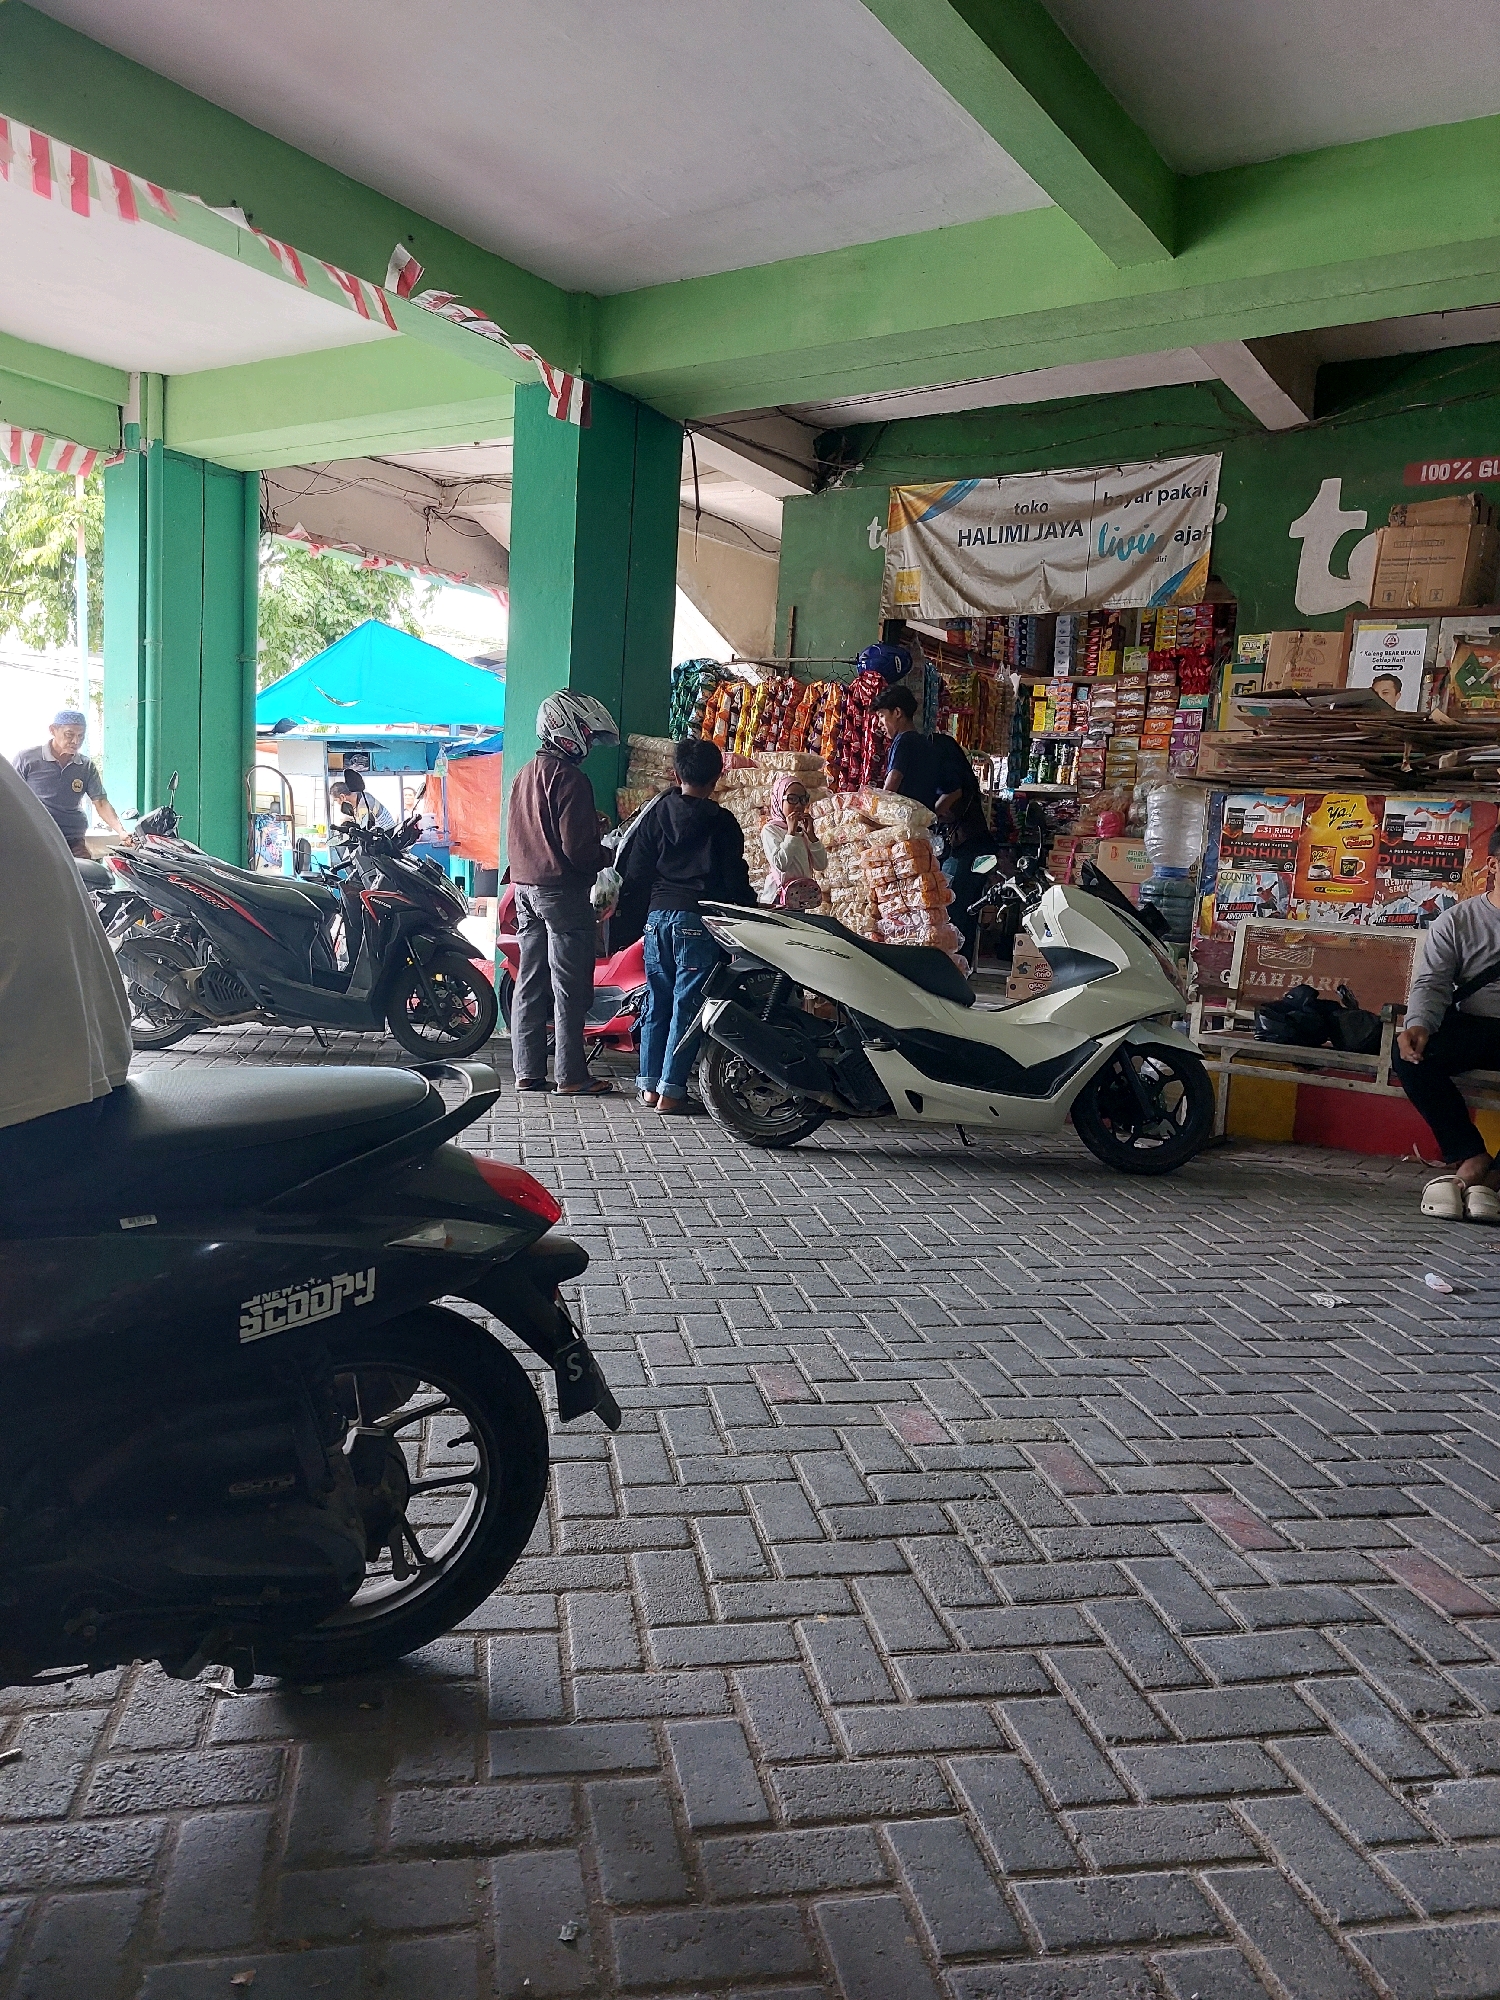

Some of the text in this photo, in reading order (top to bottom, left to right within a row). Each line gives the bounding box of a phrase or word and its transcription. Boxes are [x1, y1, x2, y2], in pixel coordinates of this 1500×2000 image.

[1421, 461, 1472, 481] 100%
[1103, 481, 1209, 509] bayar pakai
[1014, 500, 1049, 516] toko
[957, 519, 1084, 547] HALIMI JAYA
[1438, 834, 1460, 842] RIBU
[1220, 846, 1296, 860] DUNHILL
[1377, 854, 1463, 869] DUNHILL
[1220, 871, 1255, 882] COUNTRY
[1387, 914, 1416, 922] FLAVOUR
[261, 1284, 295, 1304] NEW
[239, 1266, 376, 1344] SCOOPY
[566, 1352, 583, 1382] S
